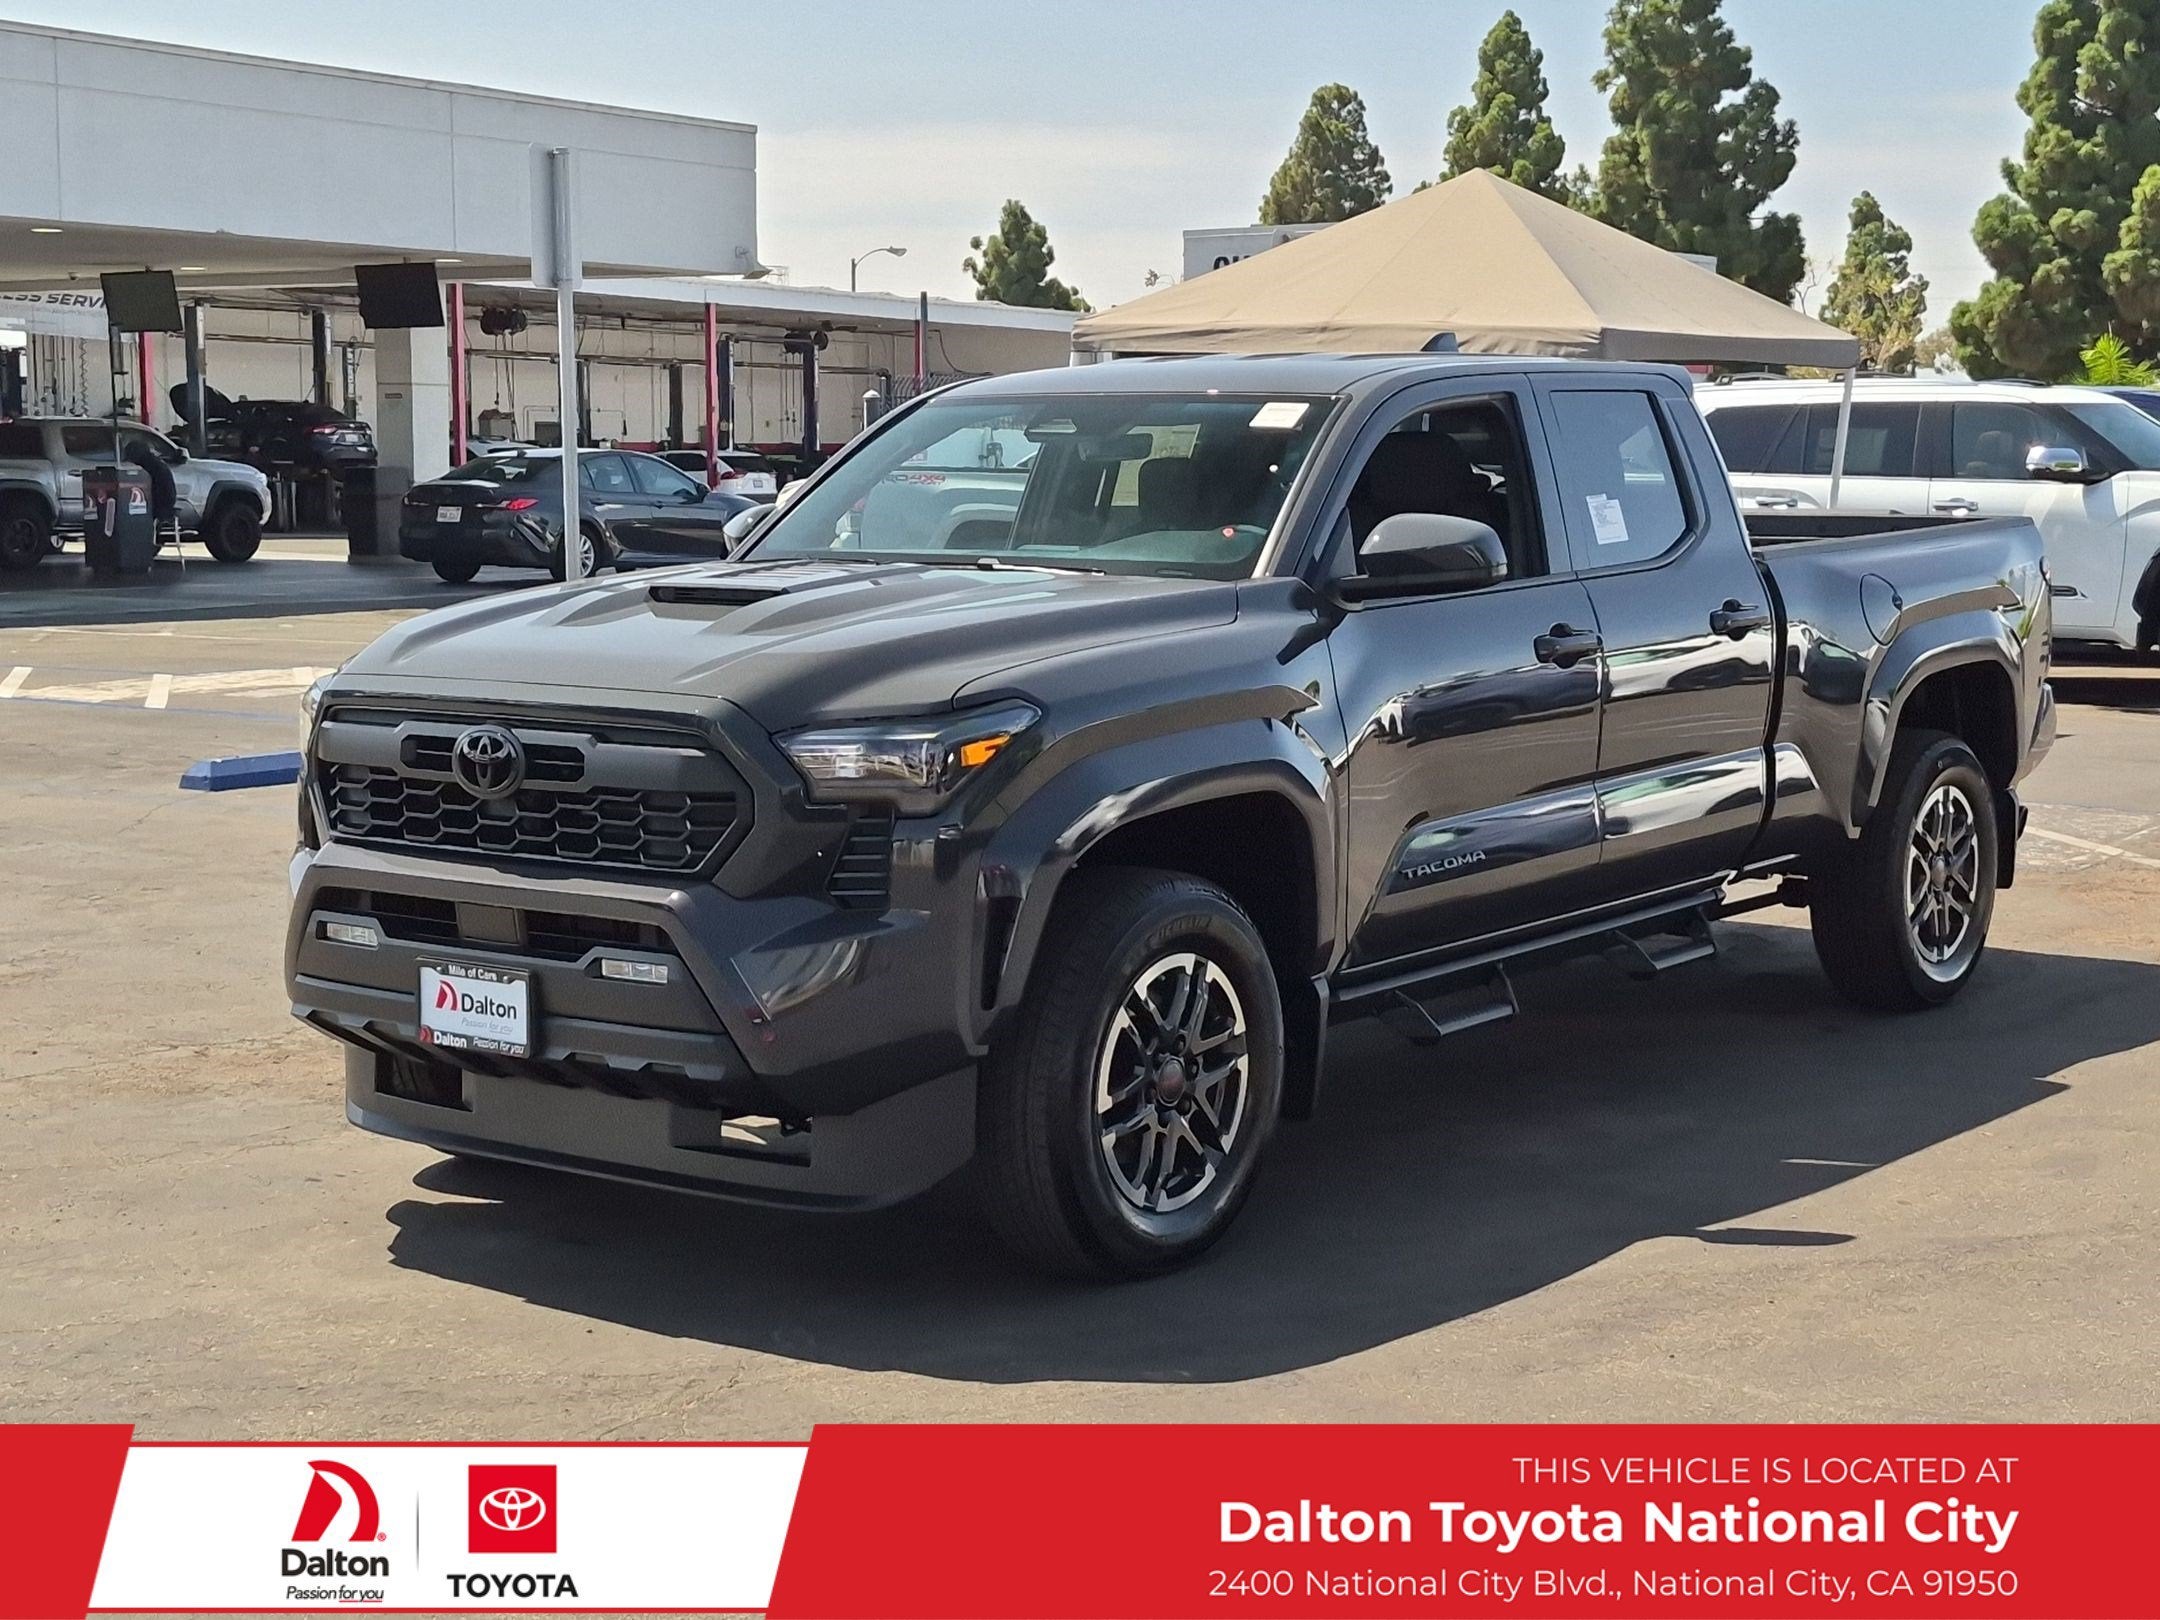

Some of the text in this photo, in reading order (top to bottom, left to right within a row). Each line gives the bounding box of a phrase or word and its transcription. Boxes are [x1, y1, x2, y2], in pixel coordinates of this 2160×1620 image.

[1402, 850, 1486, 879] TACOMA
[448, 964, 466, 977] Mile
[467, 967, 477, 978] of
[461, 993, 517, 1020] Dalton
[461, 1017, 488, 1029] Passion
[433, 1031, 525, 1055] Dalton Passion for you
